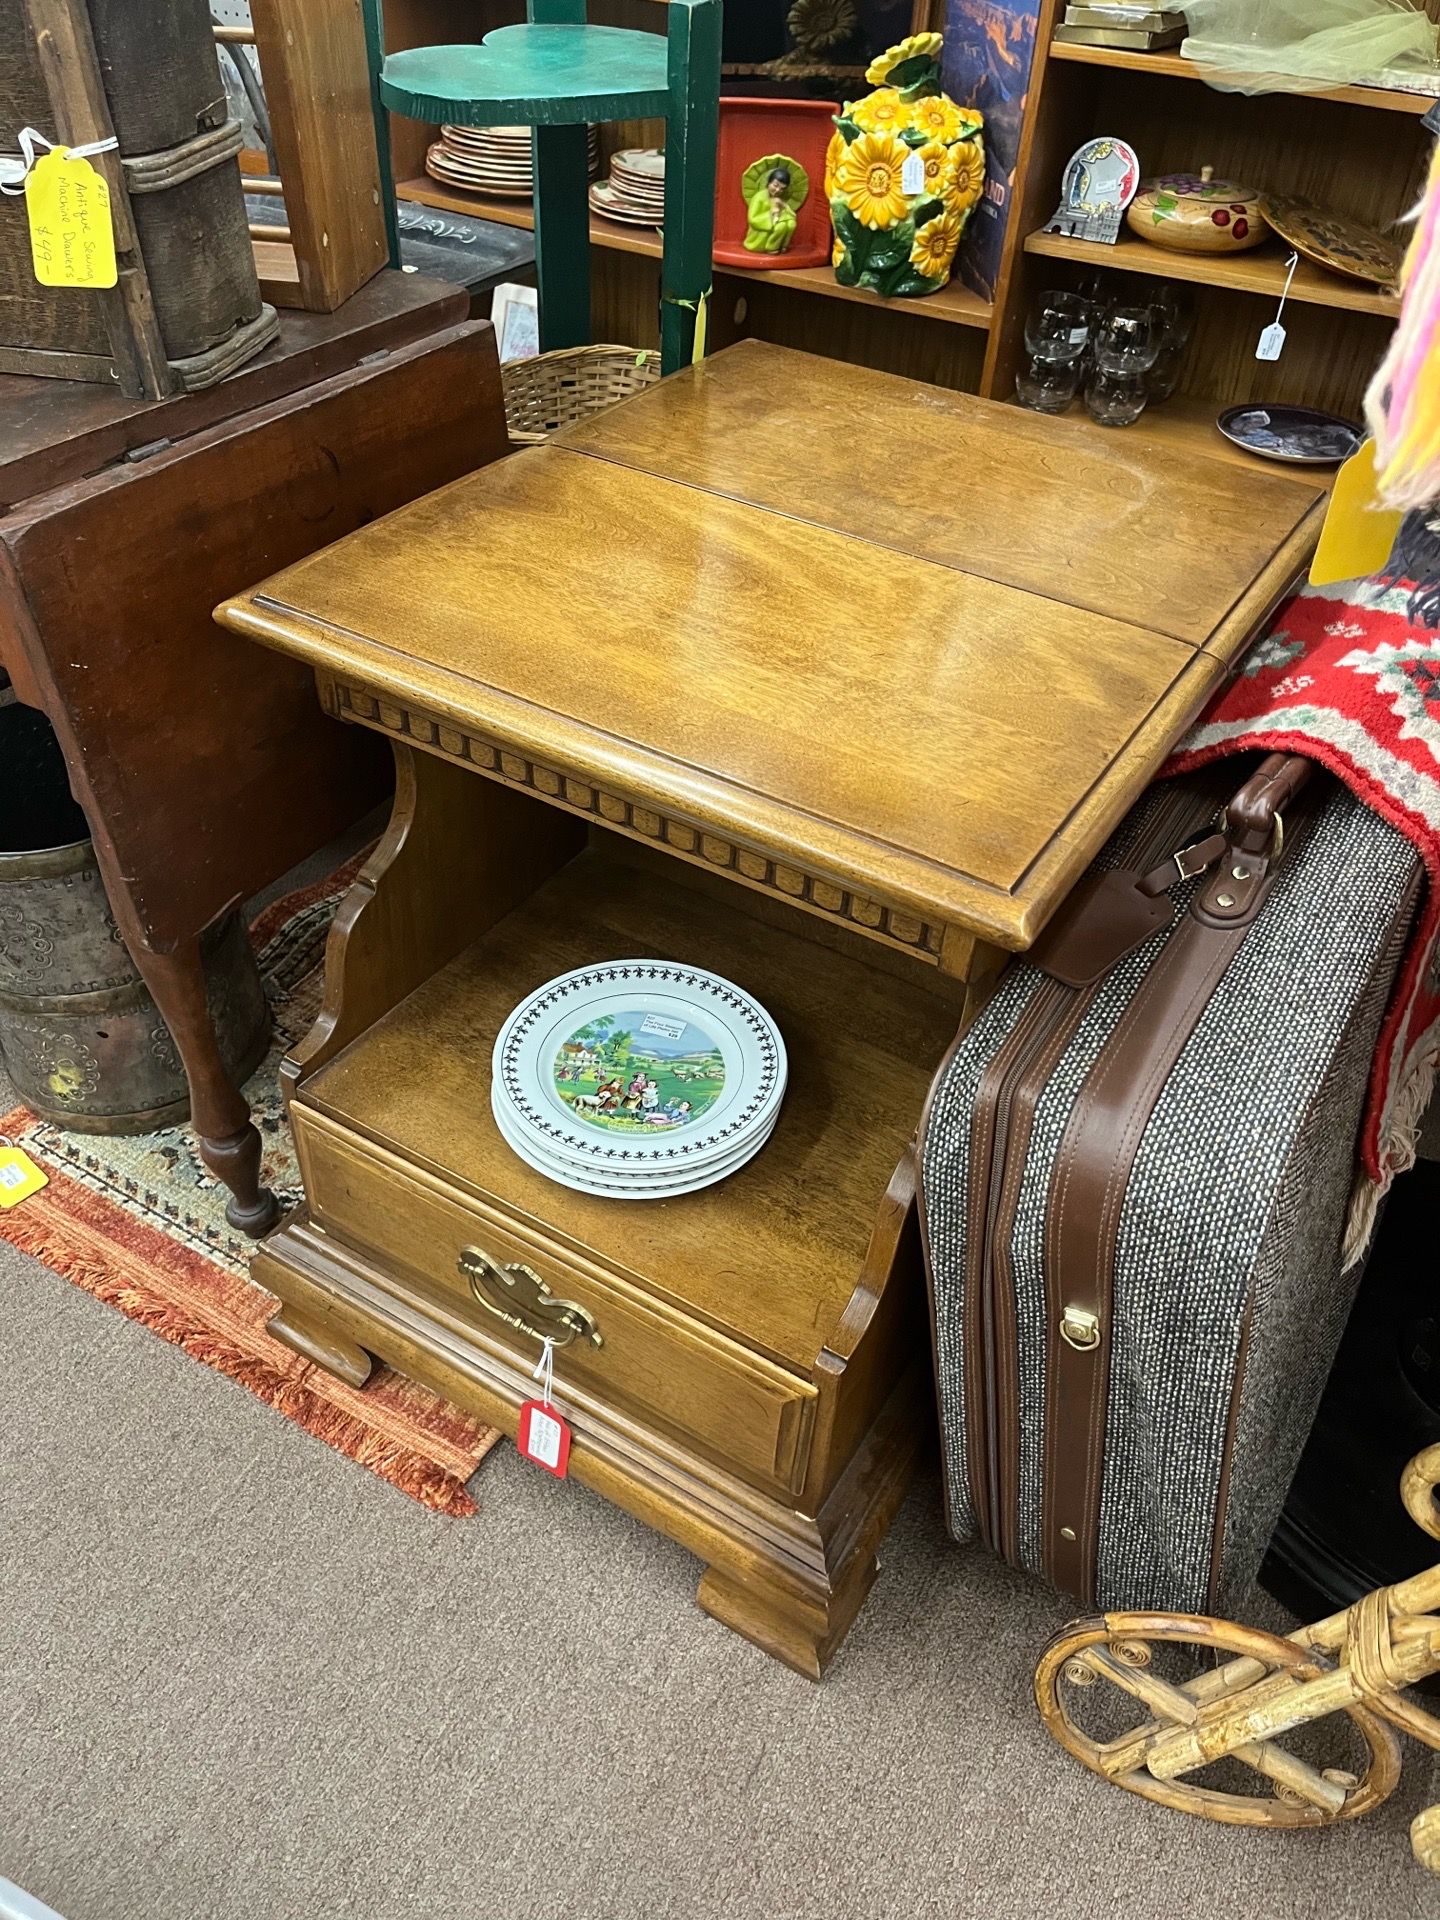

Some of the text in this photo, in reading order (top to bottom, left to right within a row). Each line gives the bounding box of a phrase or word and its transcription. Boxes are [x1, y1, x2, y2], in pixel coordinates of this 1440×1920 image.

[58, 176, 76, 278] Machine Drawers
[73, 182, 96, 283] Antique Sewing
[97, 184, 108, 208] #27
